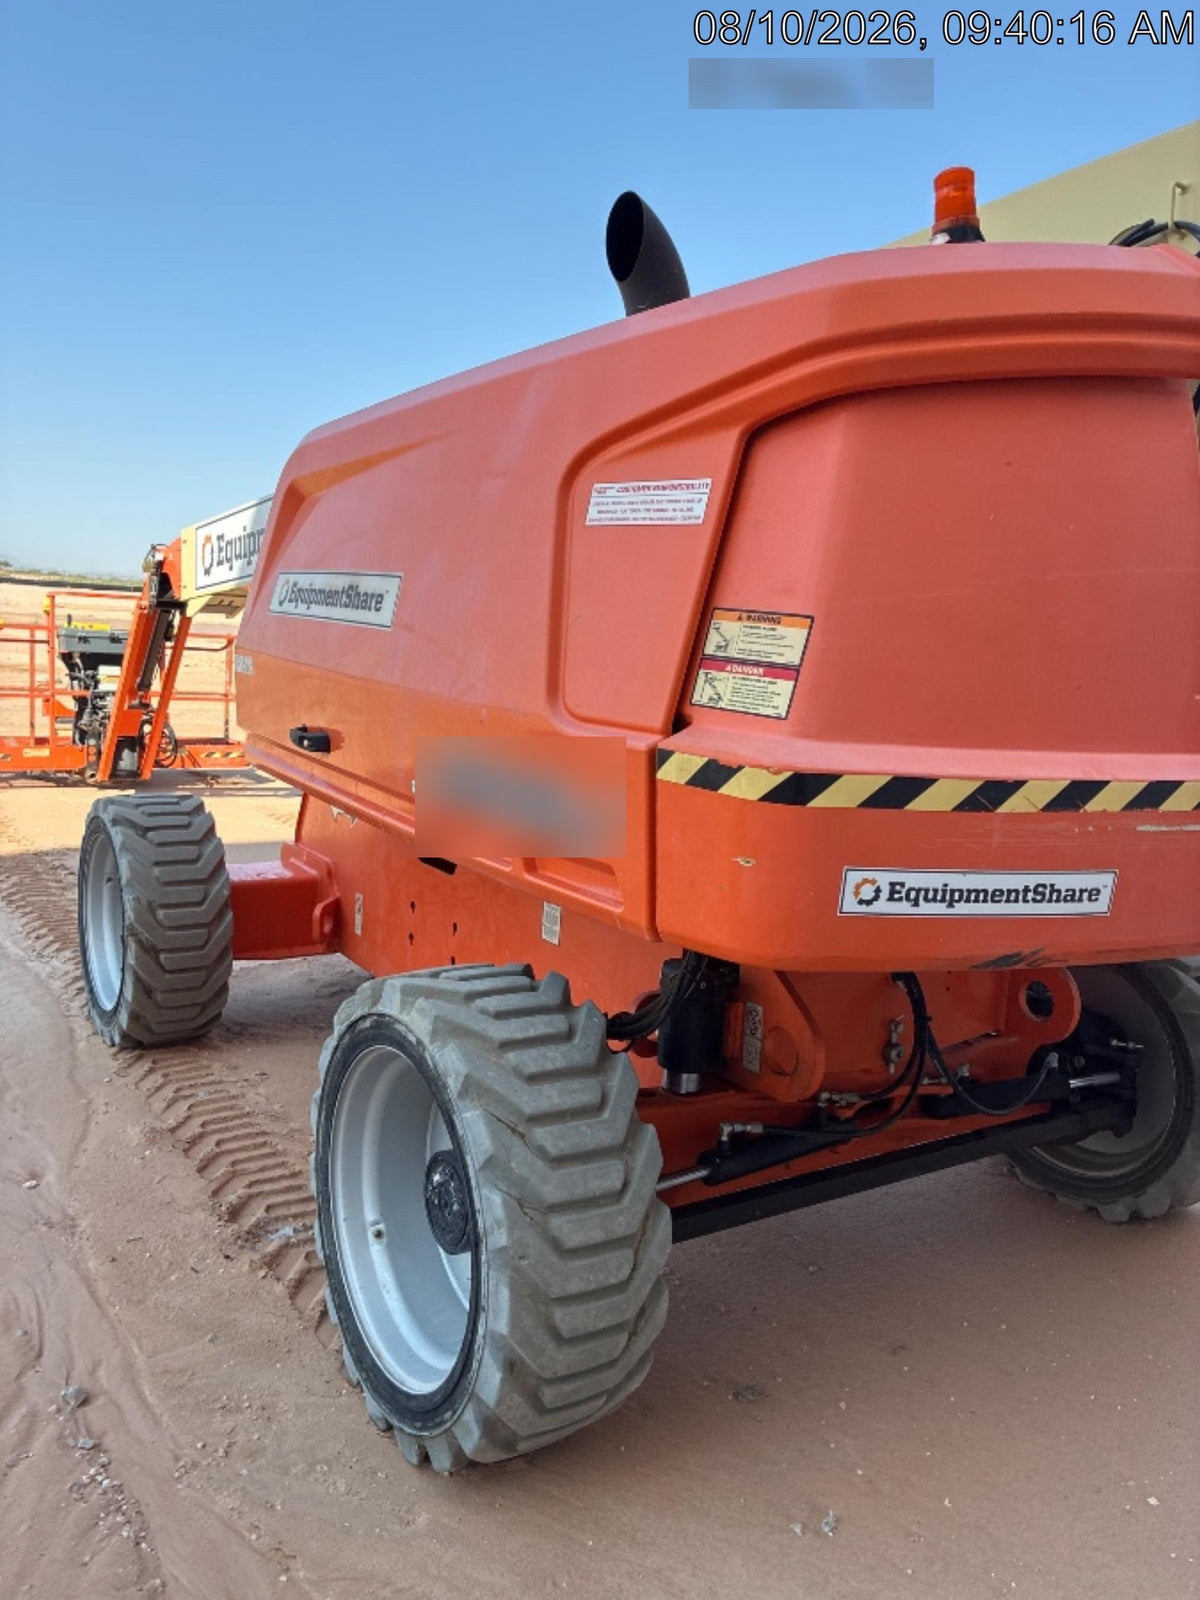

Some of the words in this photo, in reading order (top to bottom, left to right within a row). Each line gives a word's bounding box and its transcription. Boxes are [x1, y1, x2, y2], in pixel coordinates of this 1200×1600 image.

[287, 581, 384, 612] EquipmentShare
[732, 664, 765, 676] DANGER
[886, 881, 1101, 908] EquipmentShare
